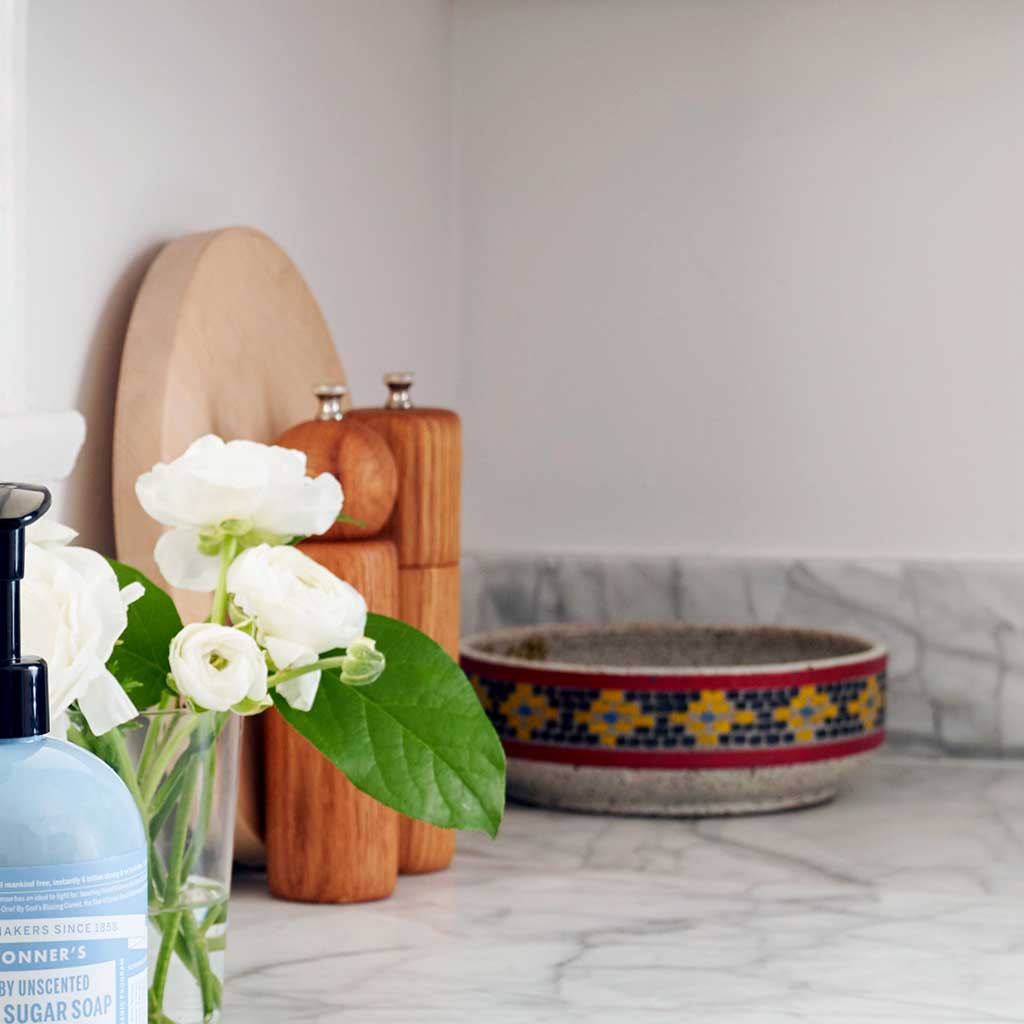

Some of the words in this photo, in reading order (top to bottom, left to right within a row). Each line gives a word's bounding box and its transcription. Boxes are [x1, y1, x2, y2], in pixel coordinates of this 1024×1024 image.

[54, 922, 92, 935] SINCE
[19, 974, 90, 997] UNSCENTED
[4, 1001, 67, 1024] SUGAR
[71, 994, 112, 1020] SOAP
